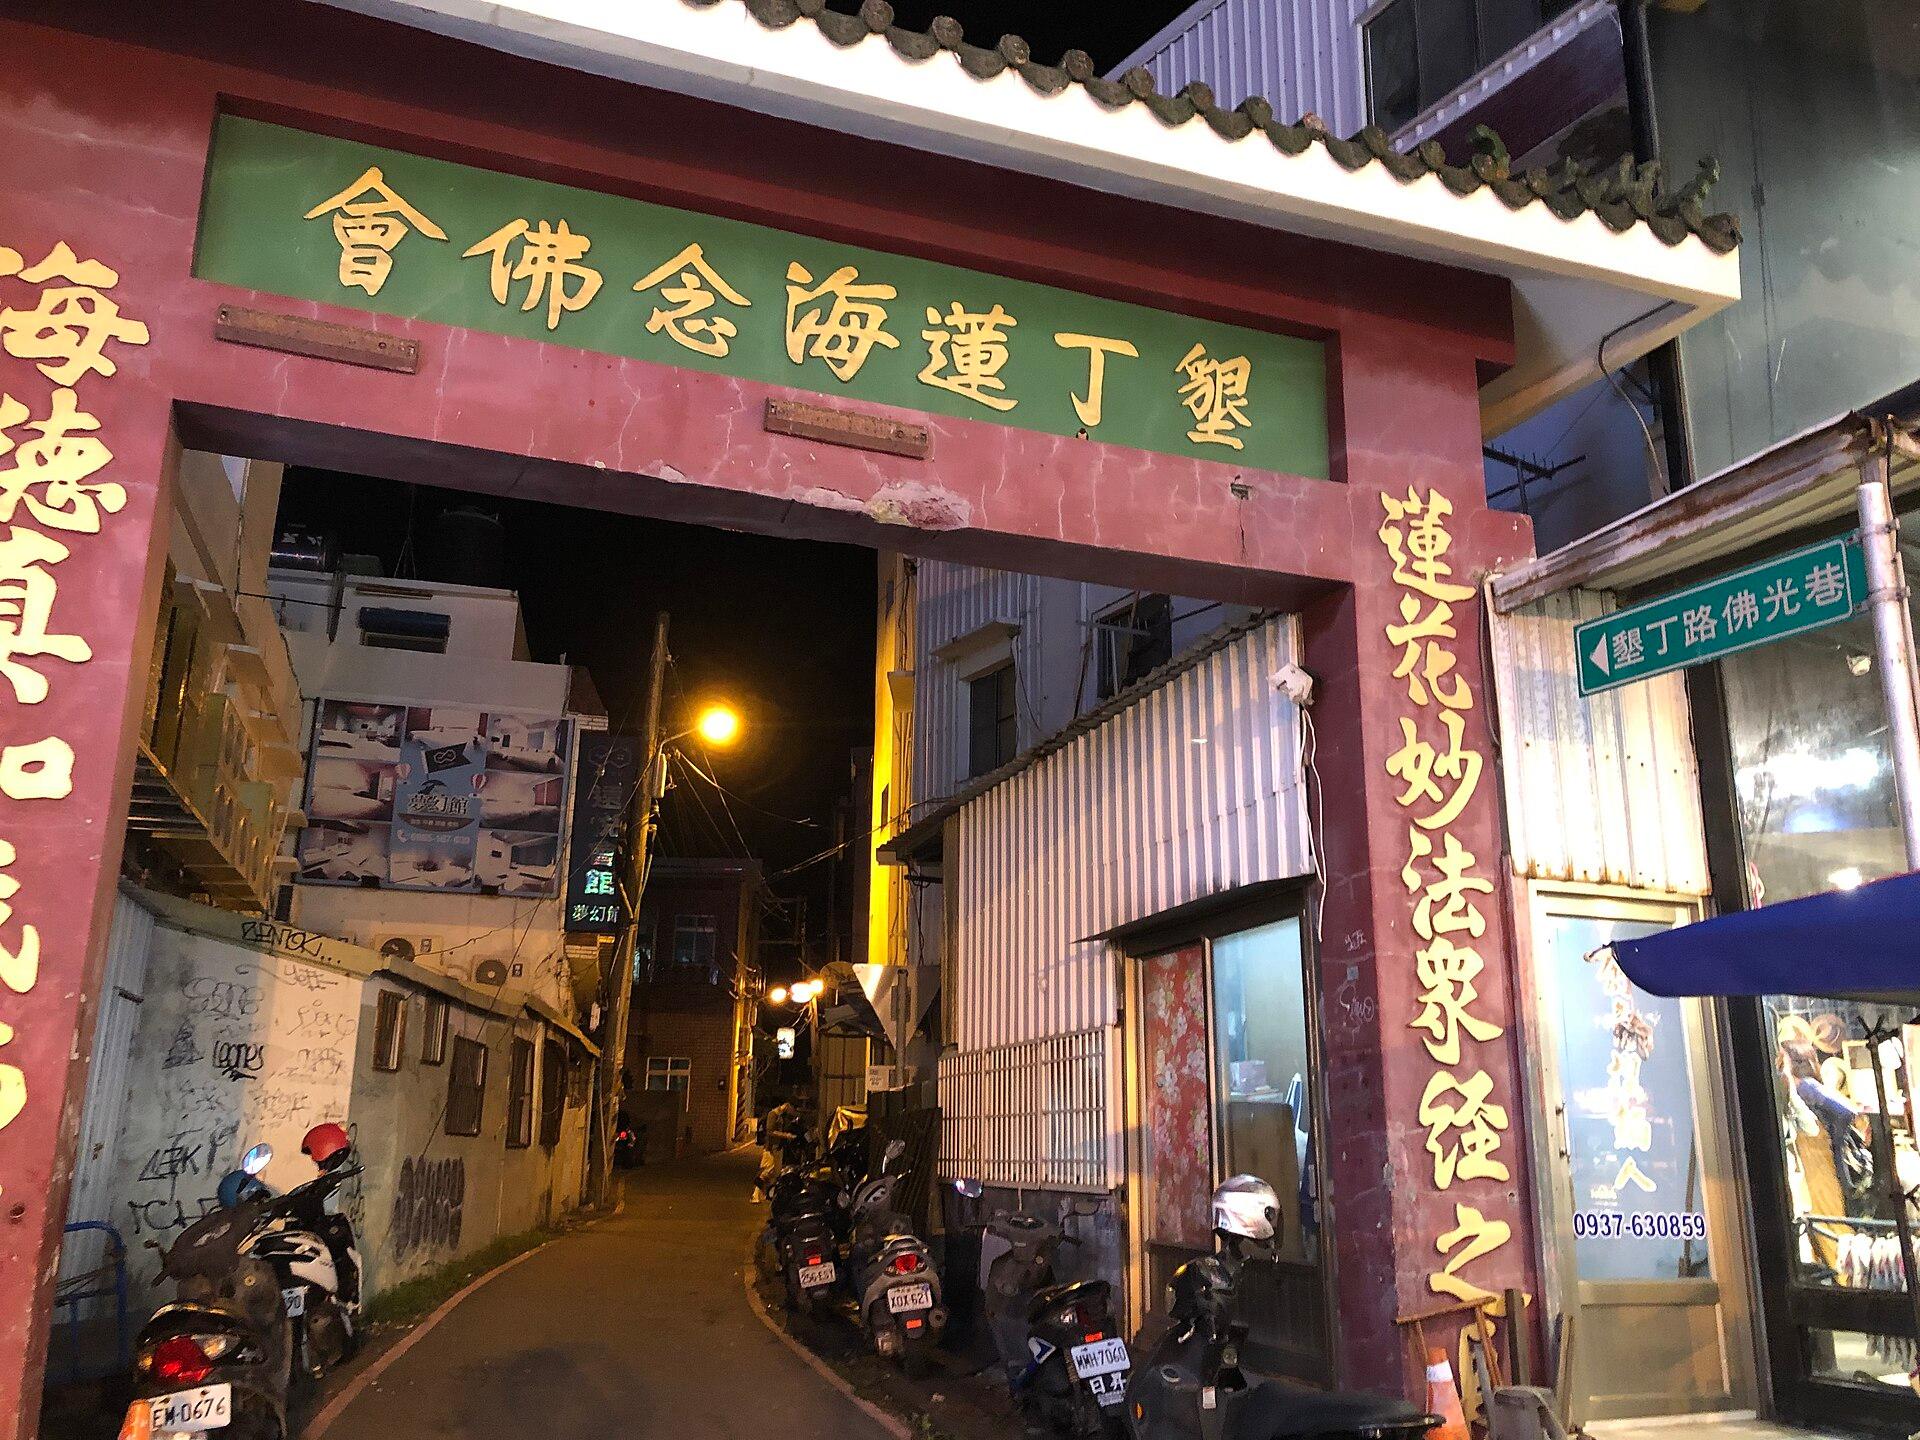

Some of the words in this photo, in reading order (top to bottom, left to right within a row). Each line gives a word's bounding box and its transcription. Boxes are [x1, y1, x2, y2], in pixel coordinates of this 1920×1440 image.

[1611, 561, 1846, 670] 墾丁路佛光巷
[1573, 1211, 1706, 1240] 0937-630859
